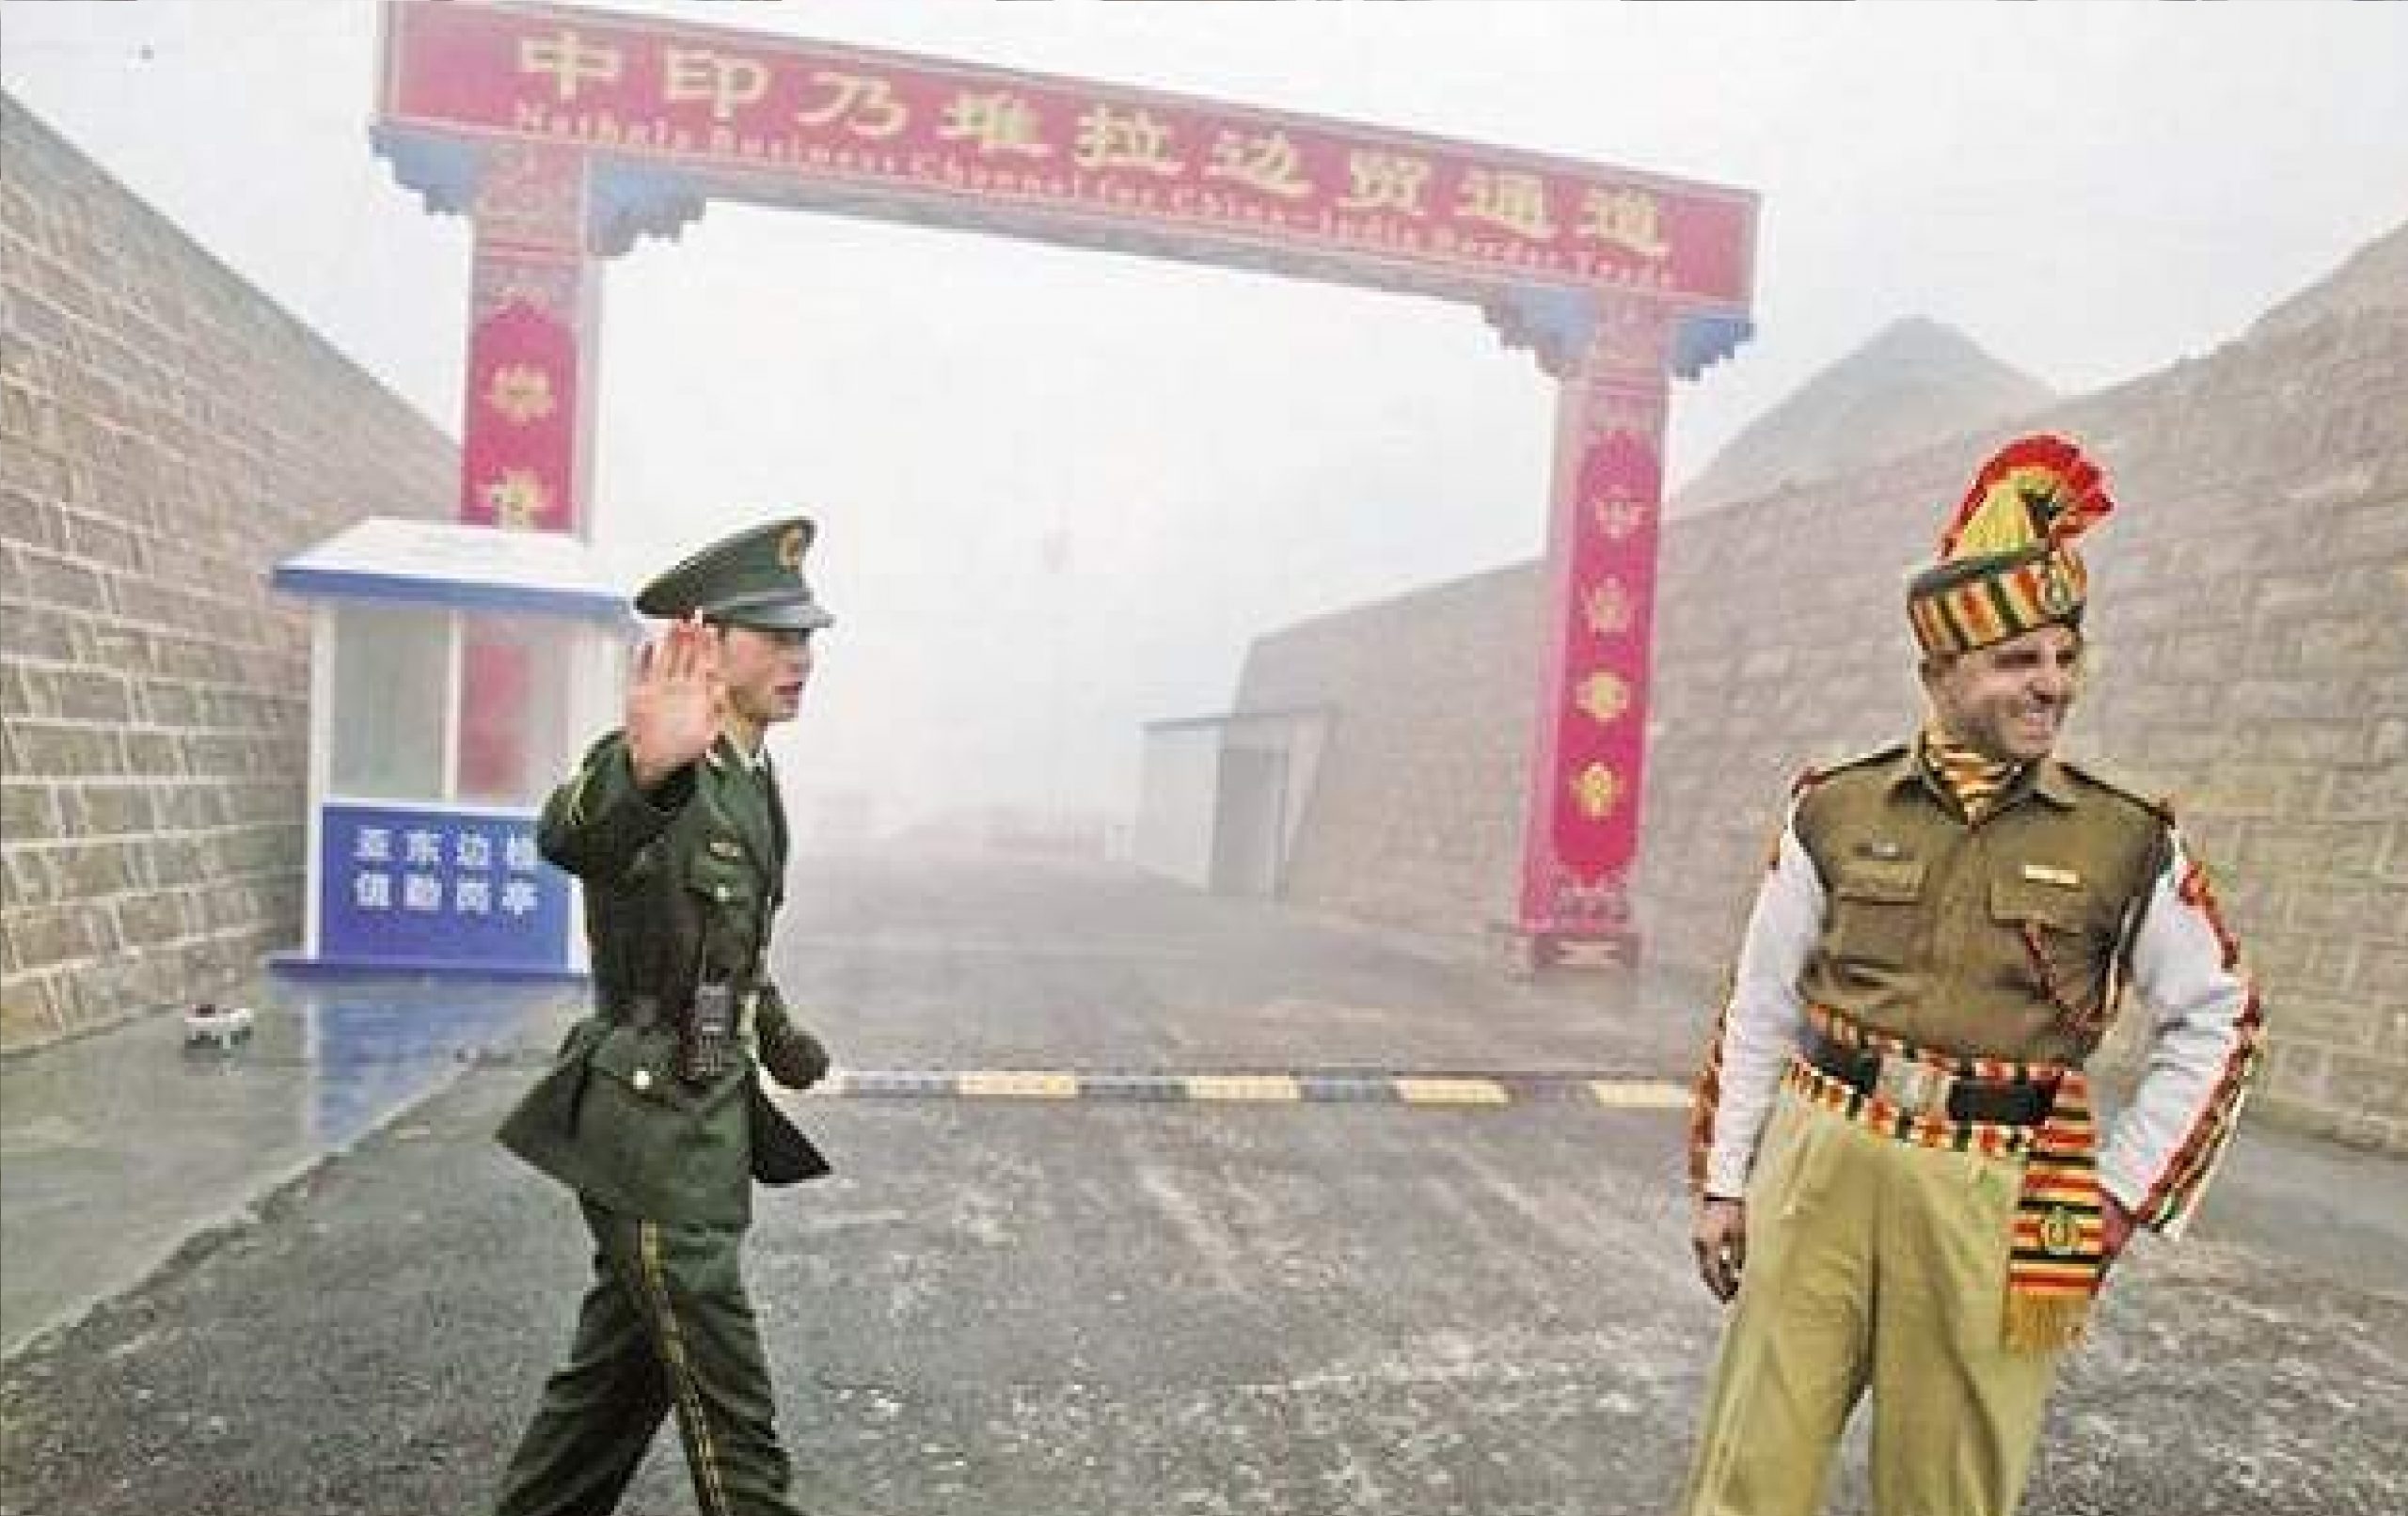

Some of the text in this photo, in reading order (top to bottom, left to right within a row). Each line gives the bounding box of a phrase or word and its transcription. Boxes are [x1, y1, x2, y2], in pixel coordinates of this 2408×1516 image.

[519, 30, 1672, 257] 中印乃堆拉边贸通道
